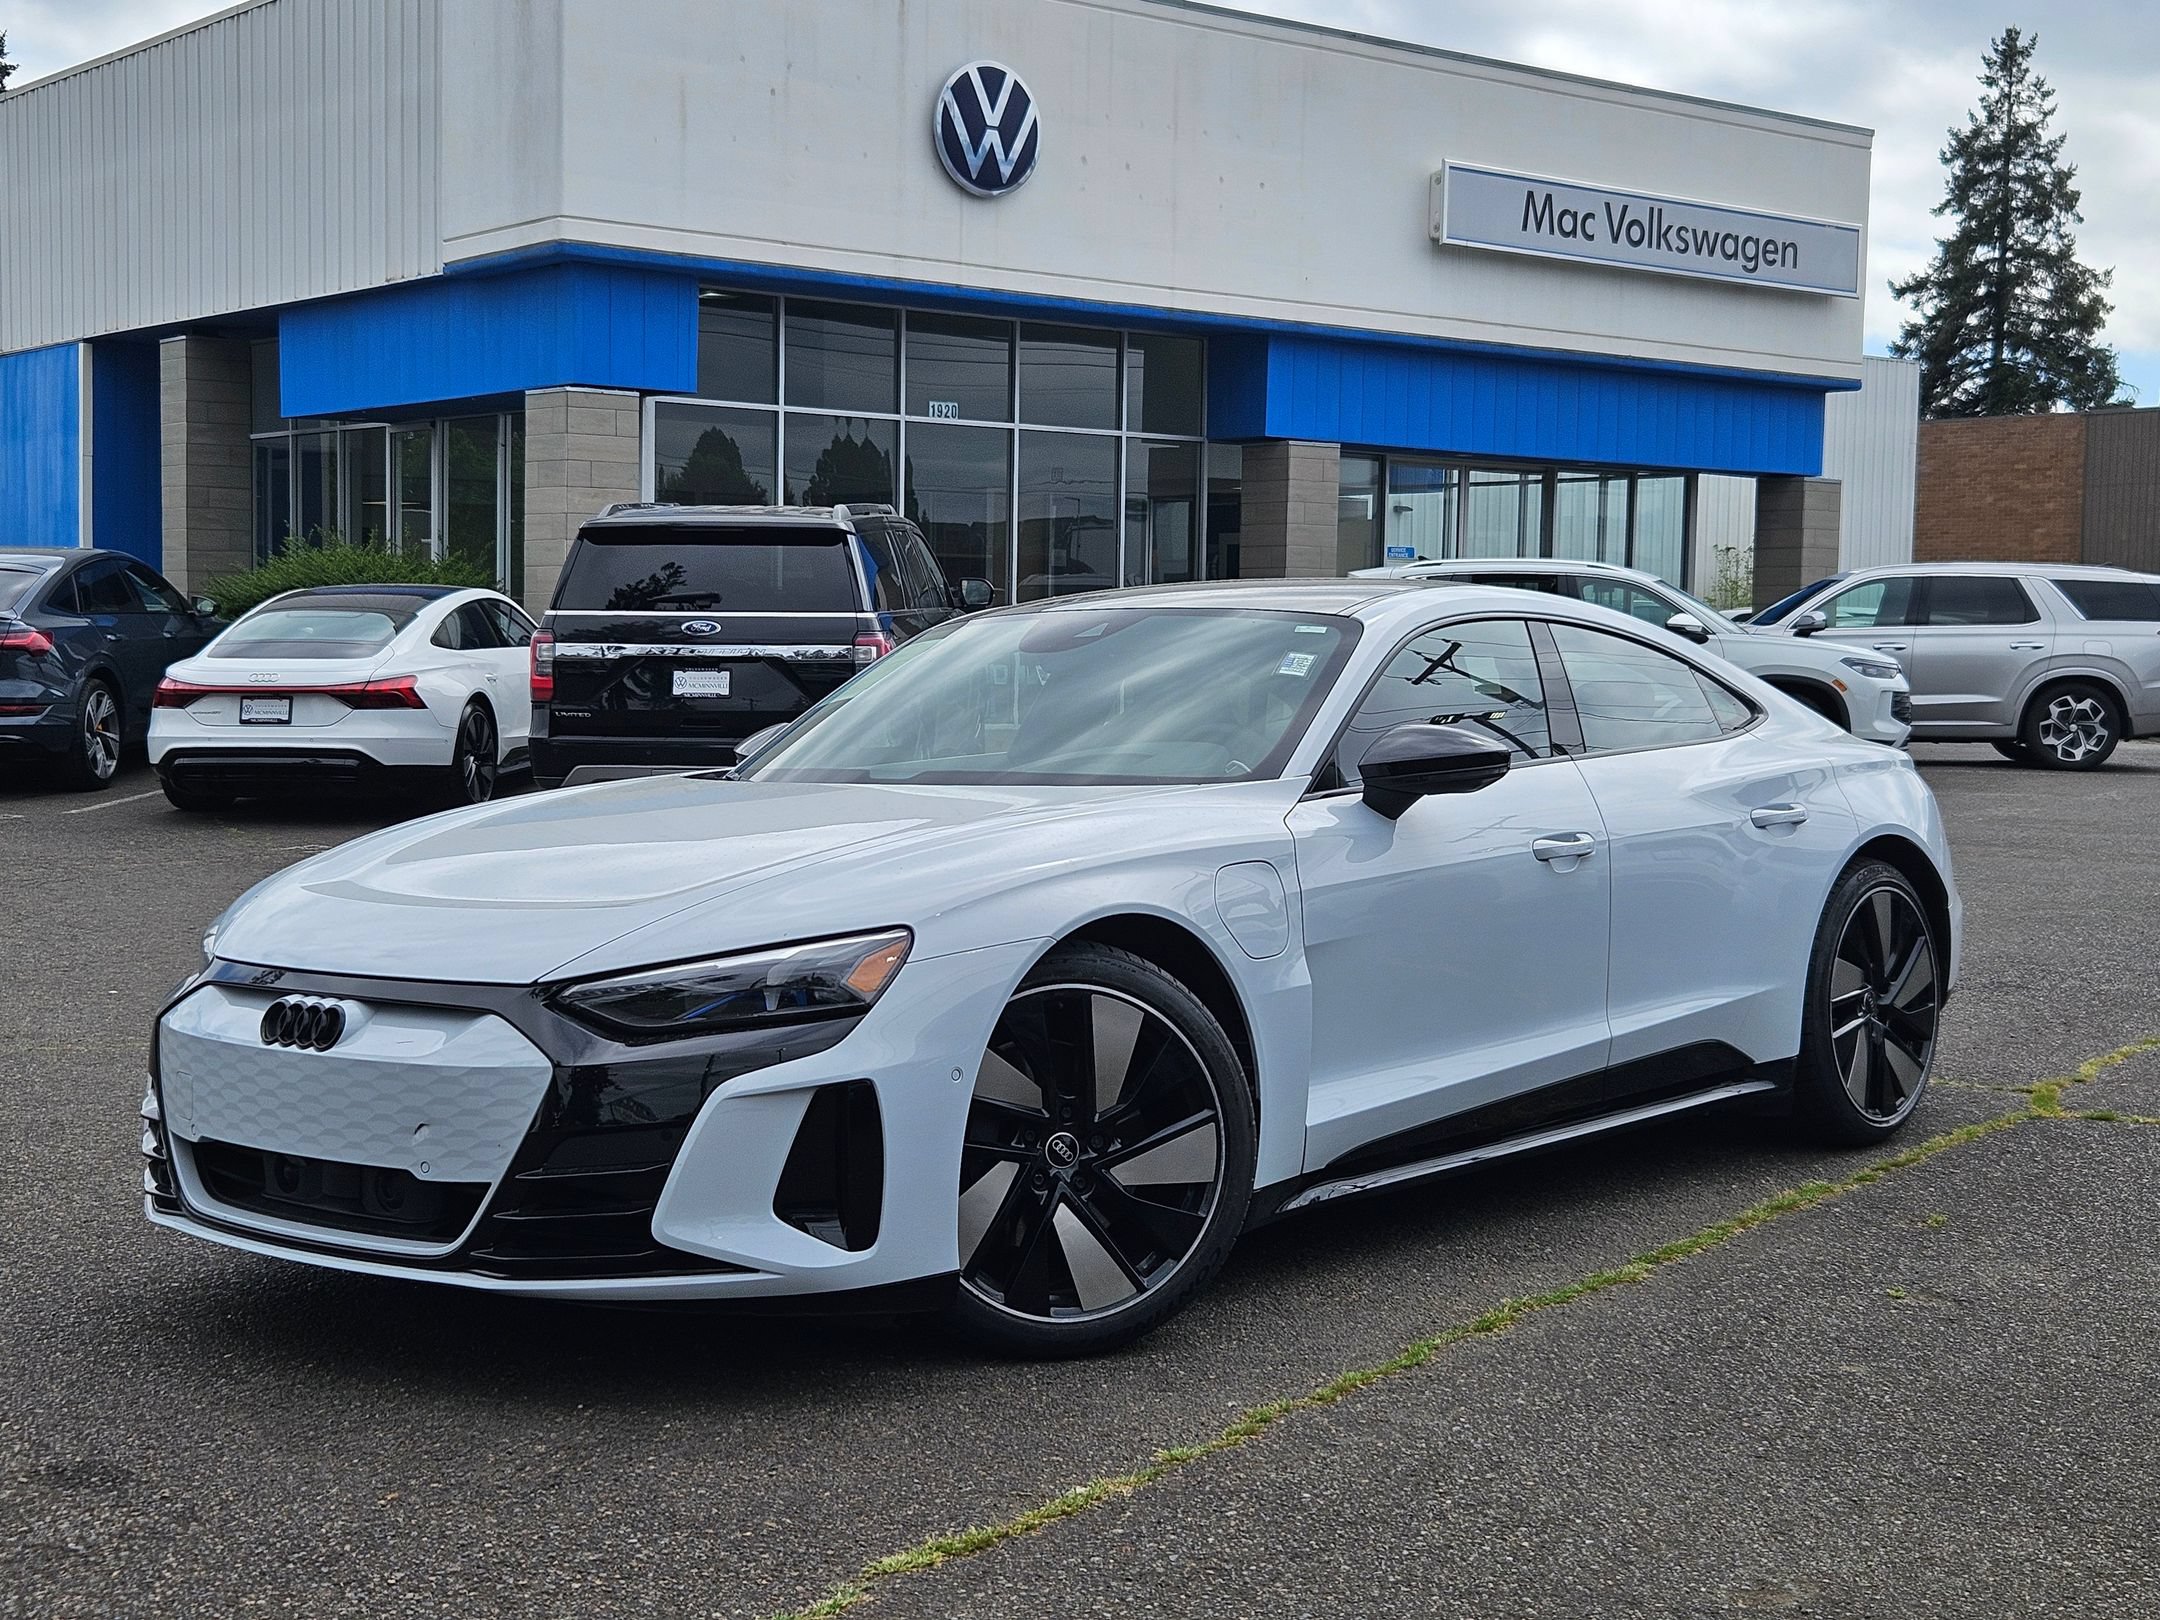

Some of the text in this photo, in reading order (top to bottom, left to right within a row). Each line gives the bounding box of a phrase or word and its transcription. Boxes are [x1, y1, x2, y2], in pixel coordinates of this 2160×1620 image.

[938, 62, 1039, 190] VW
[1521, 190, 1799, 273] Mac Volkswagen
[930, 403, 957, 419] 1920
[690, 623, 712, 632] Ford
